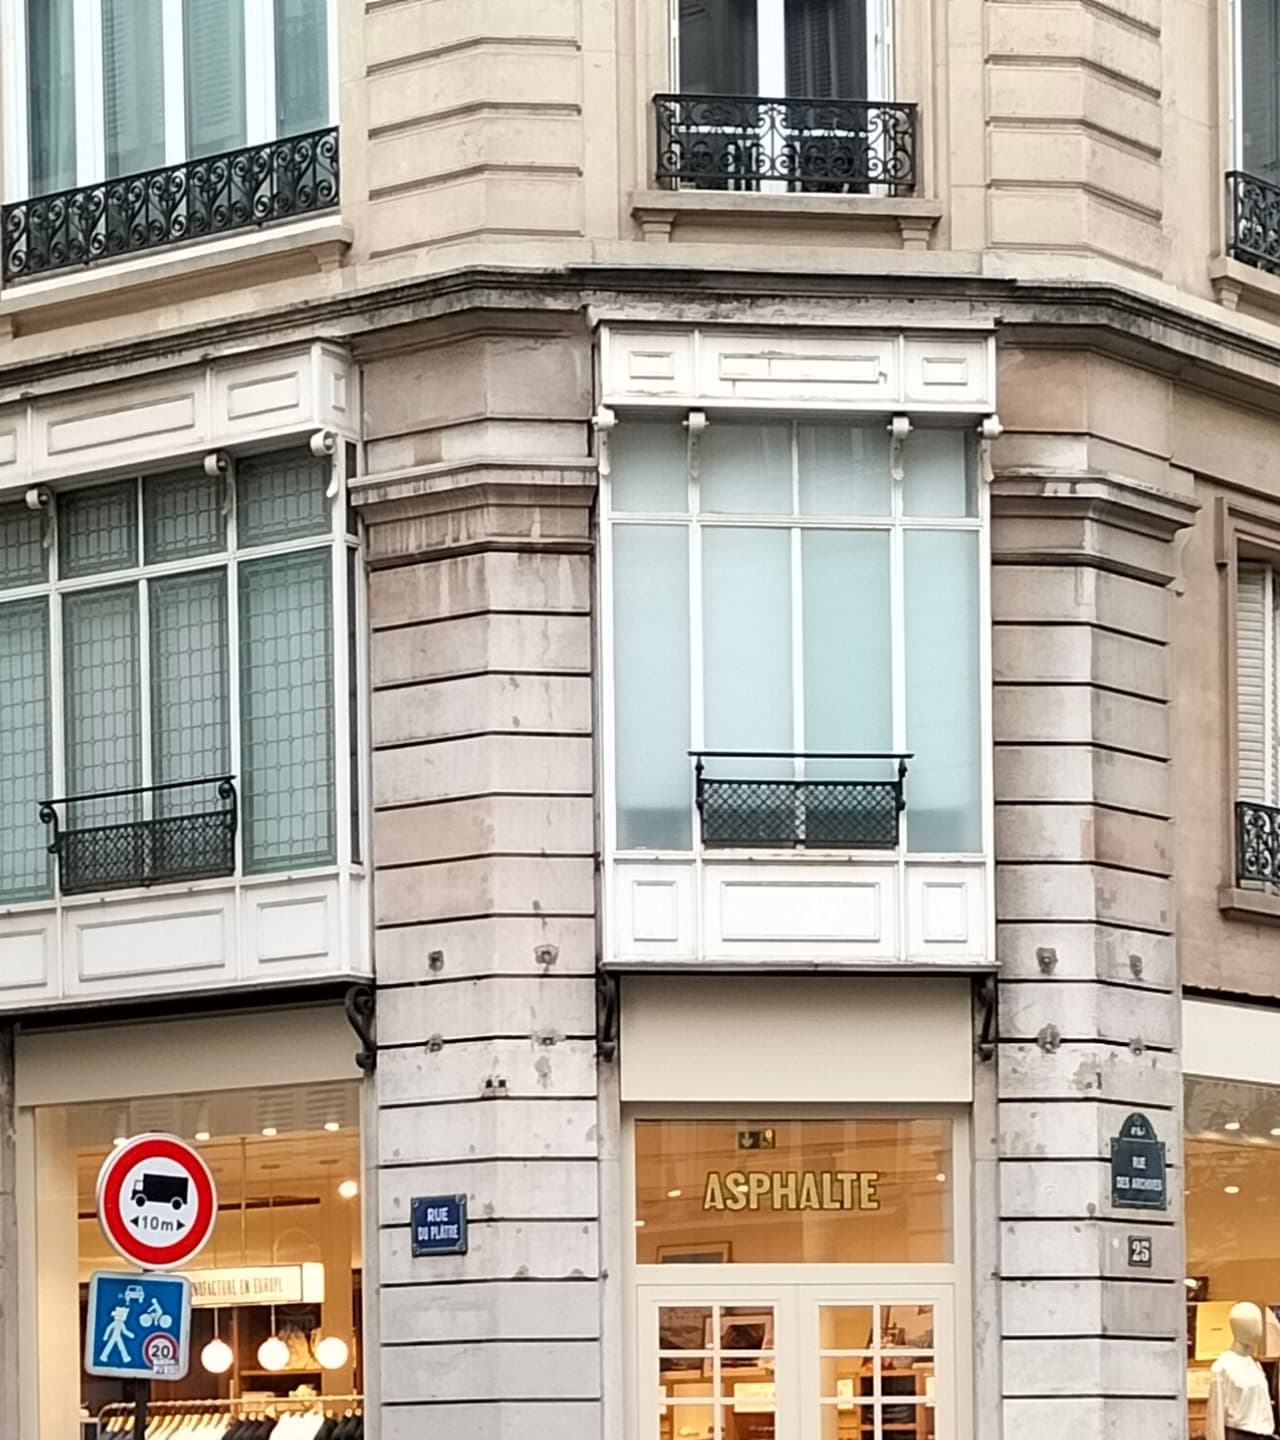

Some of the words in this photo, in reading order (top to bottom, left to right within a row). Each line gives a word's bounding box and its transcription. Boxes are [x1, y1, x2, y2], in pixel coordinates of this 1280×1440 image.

[1132, 1156, 1146, 1169] RUE
[1116, 1176, 1130, 1189] DES
[703, 1171, 880, 1211] ASPHALTE
[427, 1207, 449, 1222] RUE
[417, 1226, 429, 1241] DU
[1132, 1241, 1150, 1262] 25
[151, 1344, 171, 1359] 20
